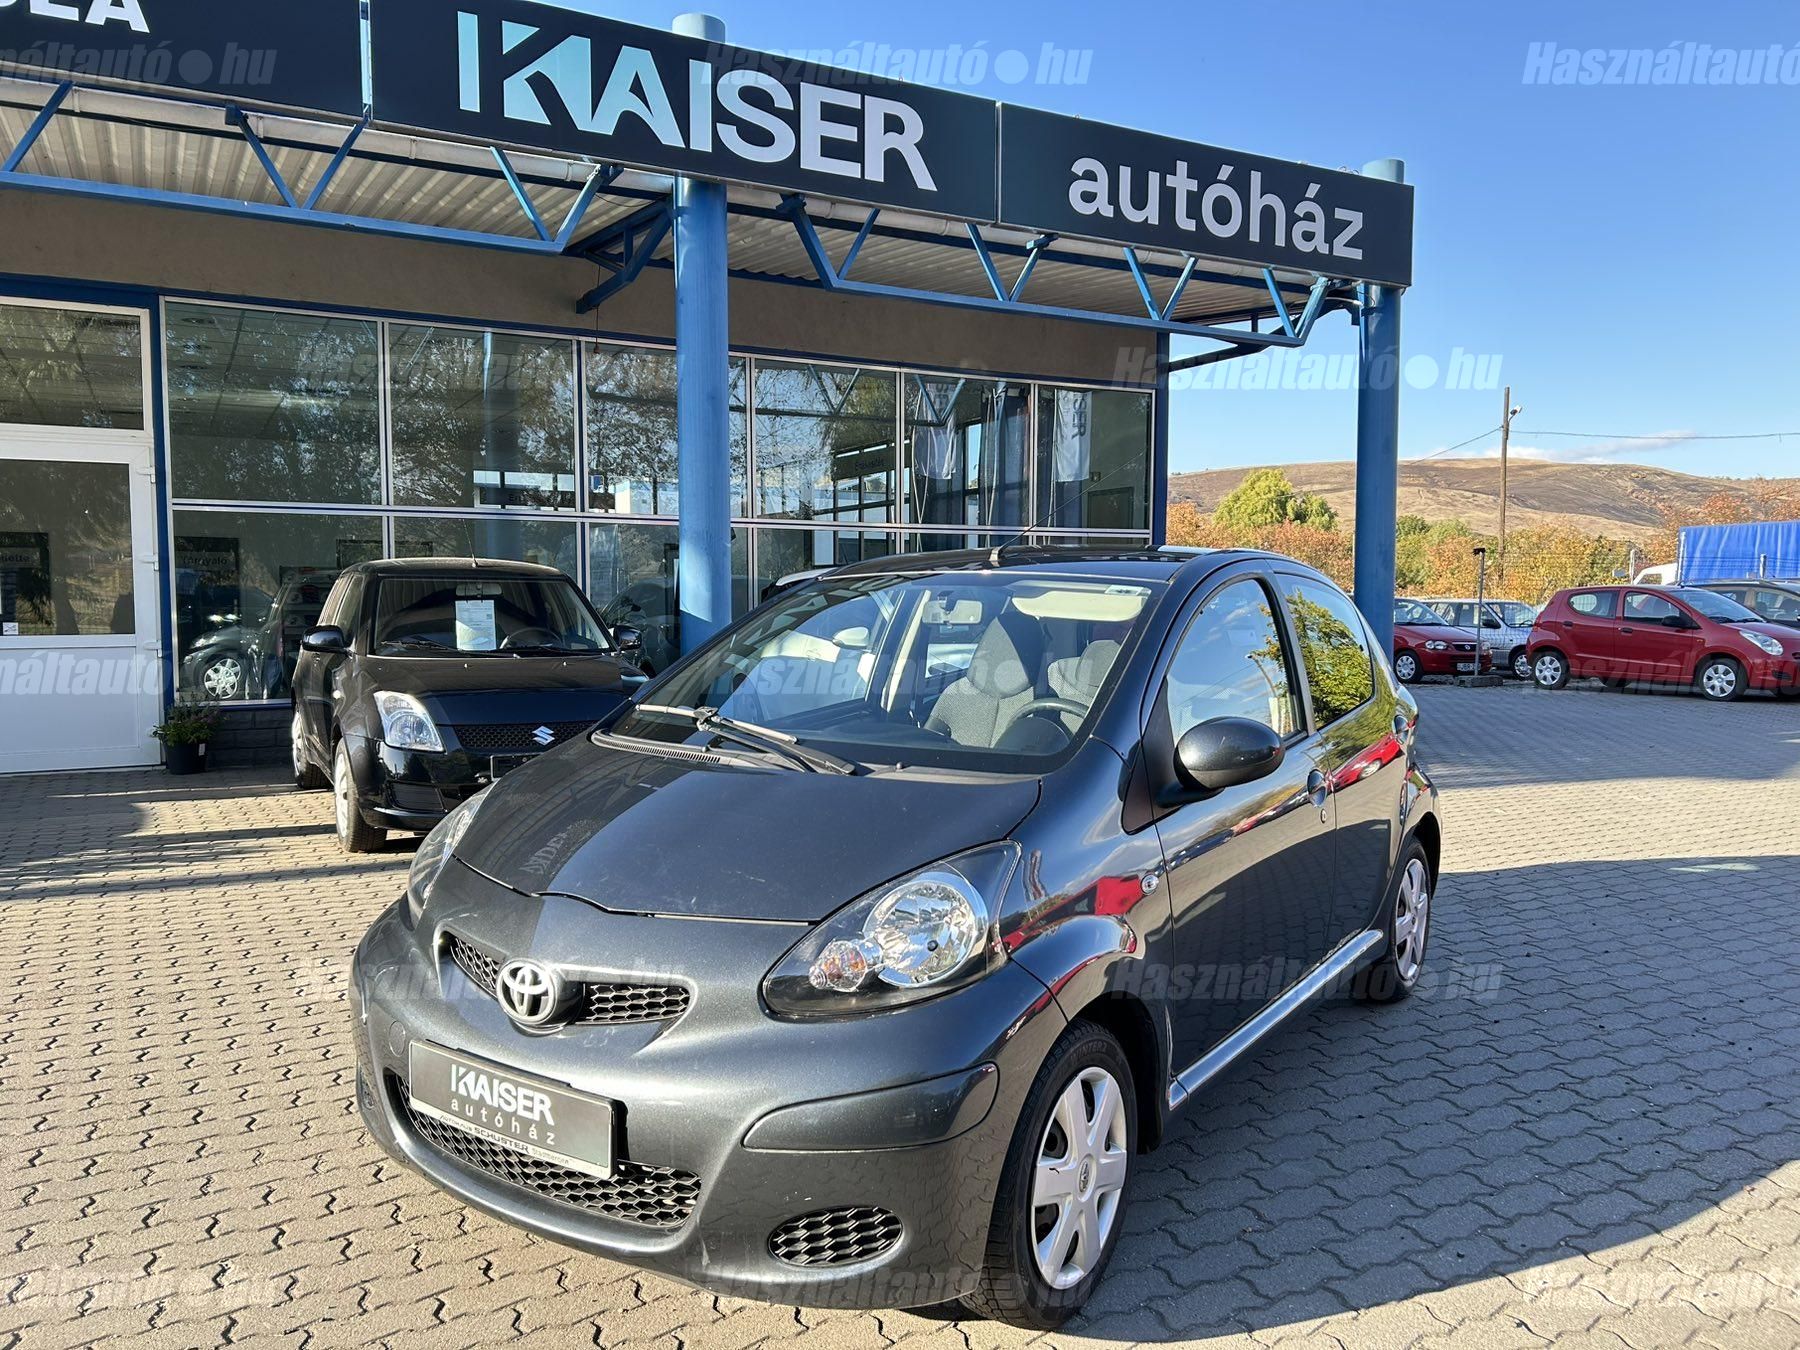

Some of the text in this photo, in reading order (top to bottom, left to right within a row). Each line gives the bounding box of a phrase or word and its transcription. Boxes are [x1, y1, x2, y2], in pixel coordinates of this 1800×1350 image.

[457, 10, 1365, 261] KAISER autóház
[451, 1064, 555, 1126] KAISER
[451, 1098, 556, 1145] autóház
[474, 1126, 530, 1155] SCHUSTER
